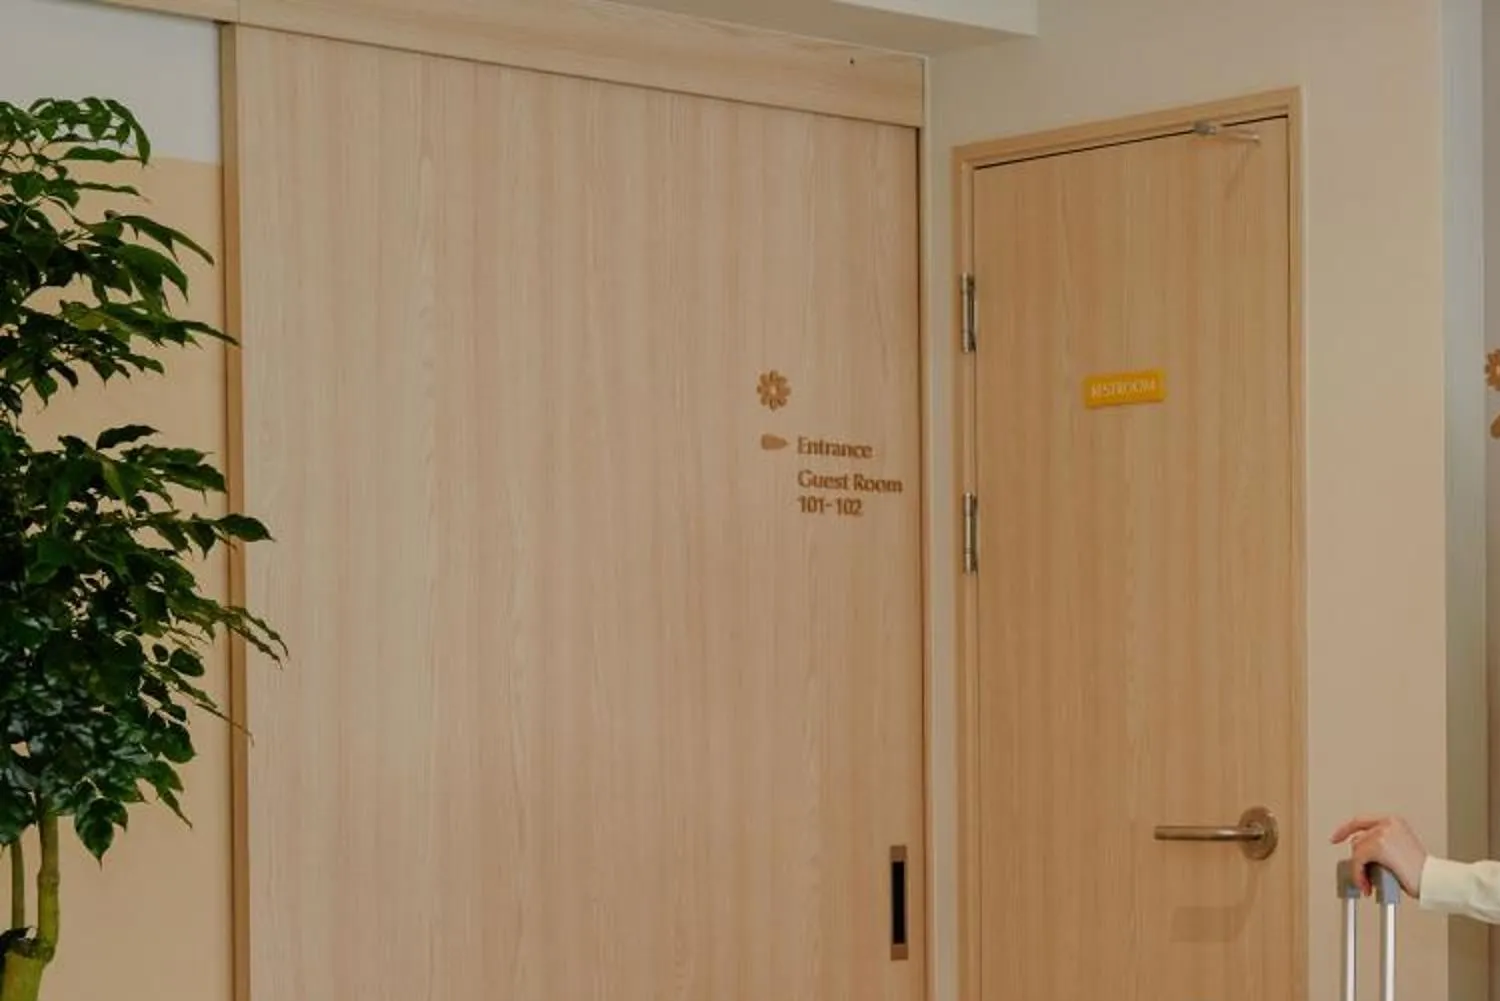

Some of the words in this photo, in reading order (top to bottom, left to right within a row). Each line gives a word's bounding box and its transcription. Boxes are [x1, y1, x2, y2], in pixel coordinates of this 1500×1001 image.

[798, 436, 873, 459] Entrance
[798, 469, 848, 490] Guest
[854, 473, 904, 493] Room
[798, 495, 863, 517] 101-102
